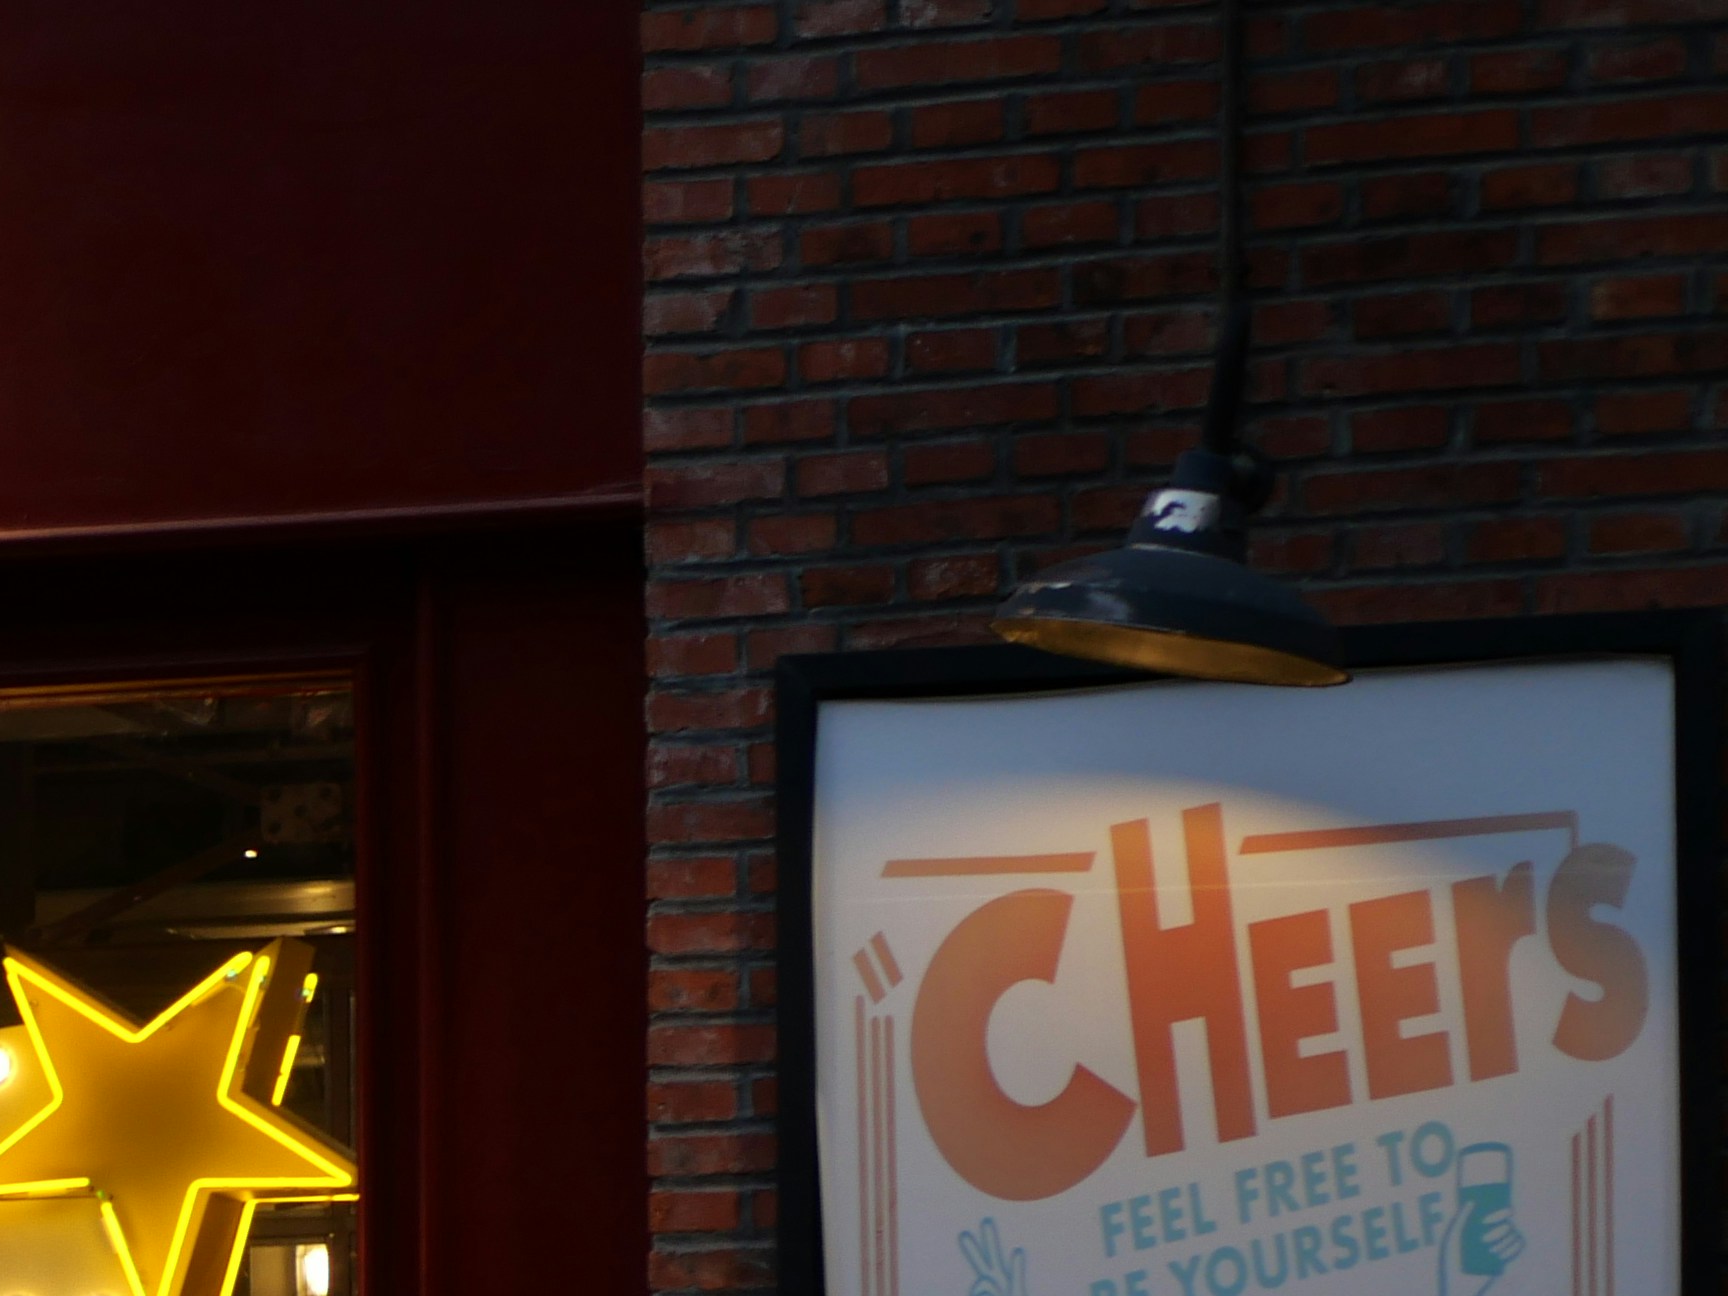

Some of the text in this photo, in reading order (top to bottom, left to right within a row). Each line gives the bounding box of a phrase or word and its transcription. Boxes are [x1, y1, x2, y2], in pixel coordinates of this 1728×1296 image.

[1099, 1120, 1455, 1257] FEEL FREE TO
